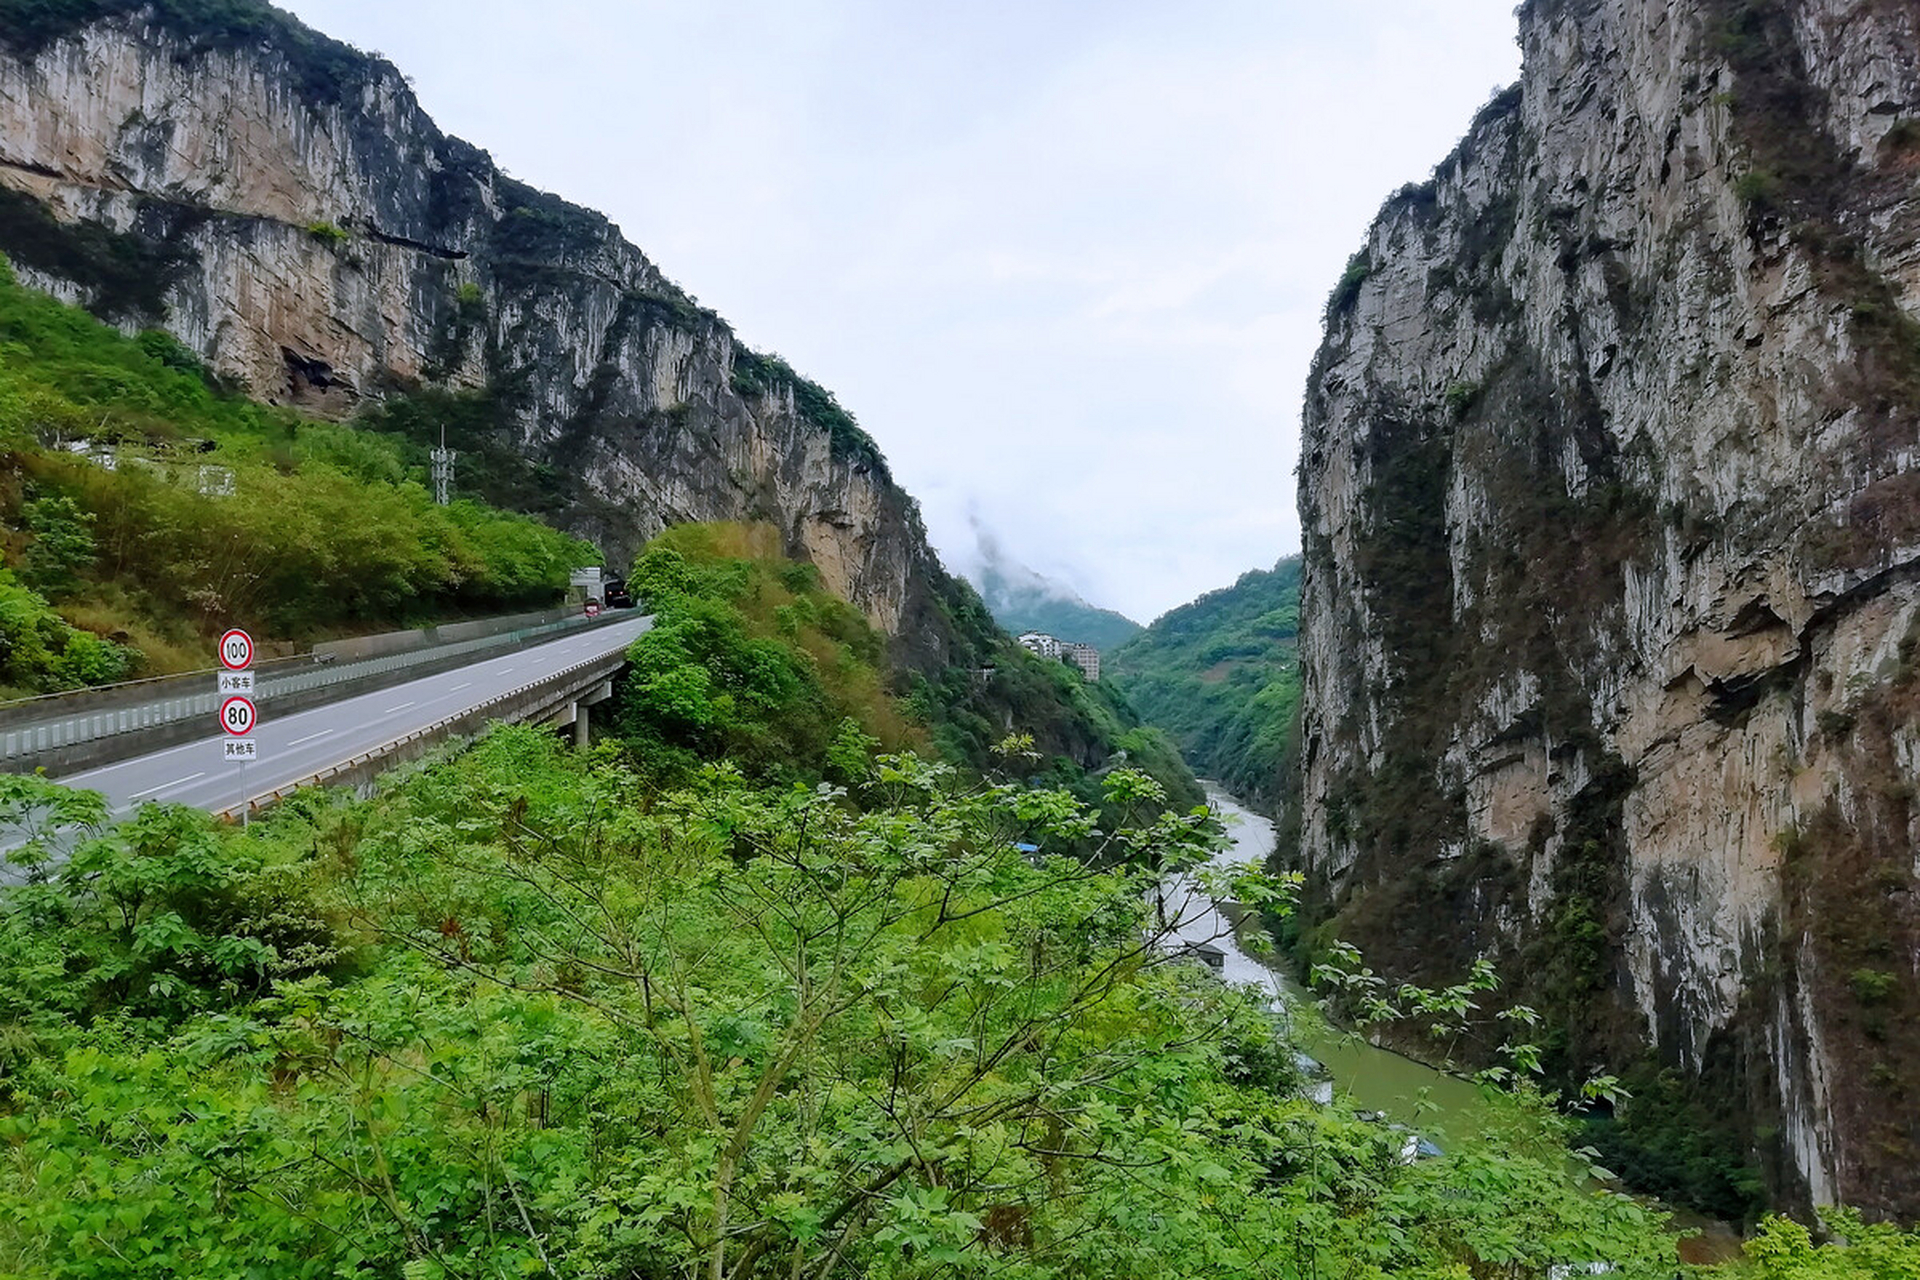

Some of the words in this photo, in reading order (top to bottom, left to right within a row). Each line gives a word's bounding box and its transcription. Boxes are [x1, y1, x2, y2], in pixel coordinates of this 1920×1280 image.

[226, 643, 247, 659] 100
[222, 677, 251, 689] 小客车
[228, 706, 248, 726] 80
[226, 743, 255, 755] 其他车
